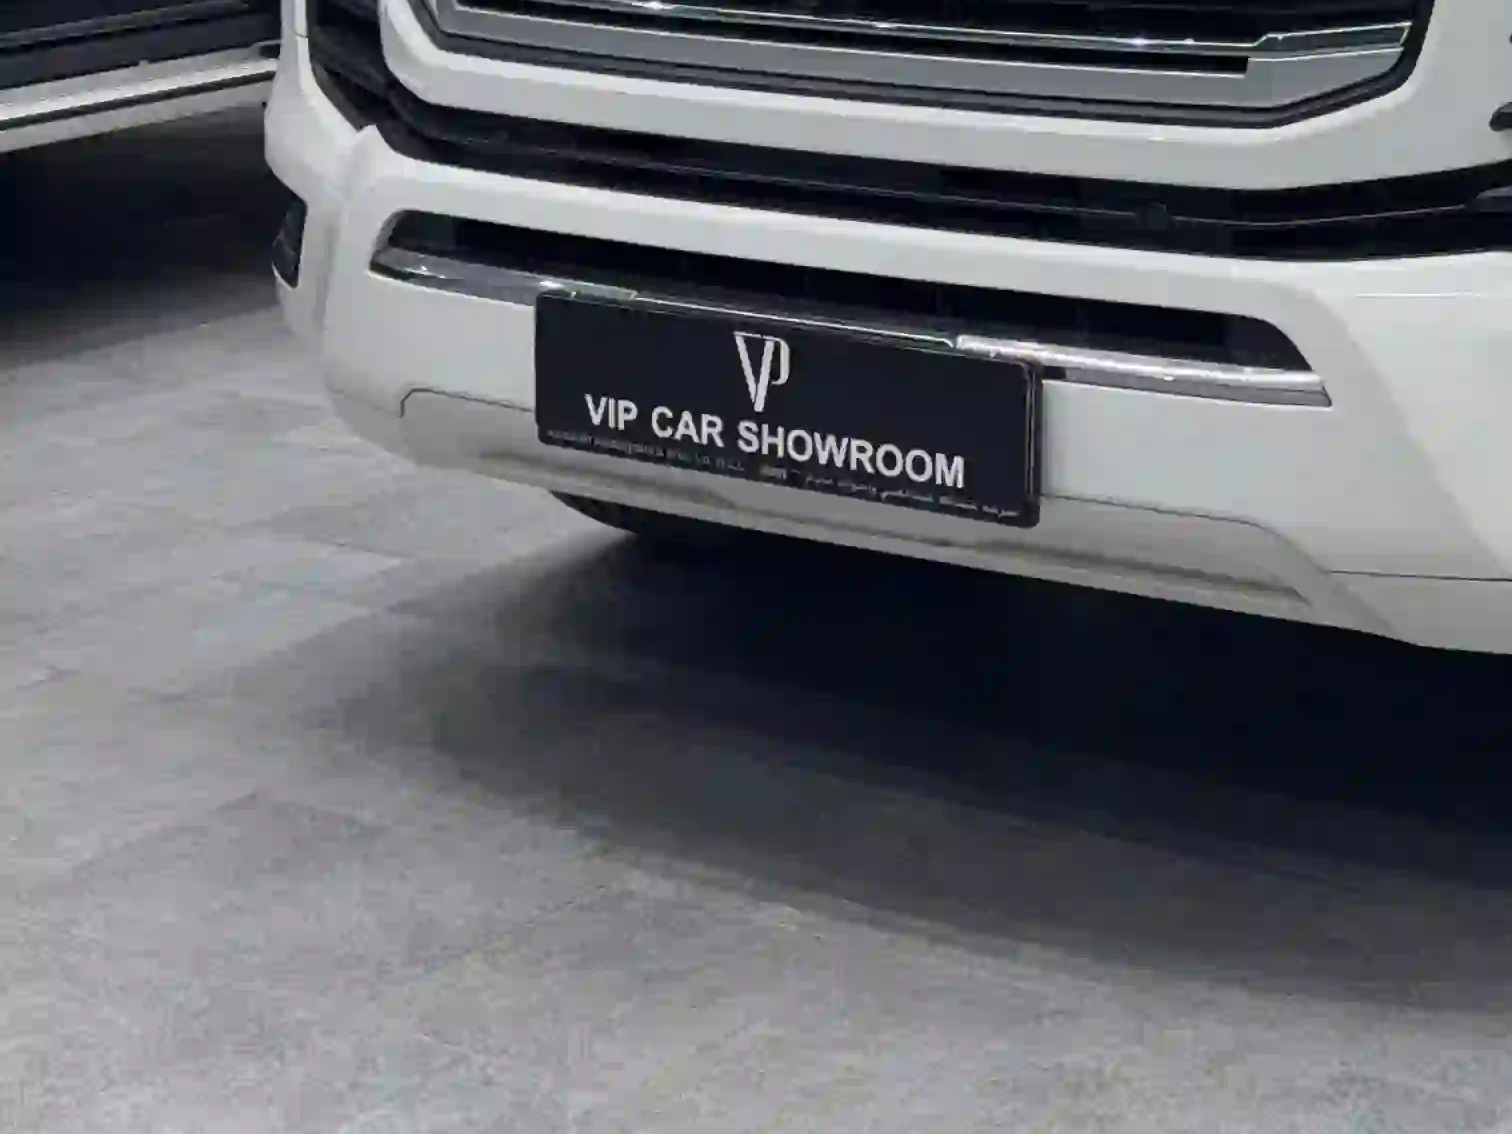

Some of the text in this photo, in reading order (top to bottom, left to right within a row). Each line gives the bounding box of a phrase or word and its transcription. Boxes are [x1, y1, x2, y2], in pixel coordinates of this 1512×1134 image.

[584, 393, 638, 430] VIP
[651, 406, 725, 447] CAR
[737, 420, 965, 488] SHOWROOM
